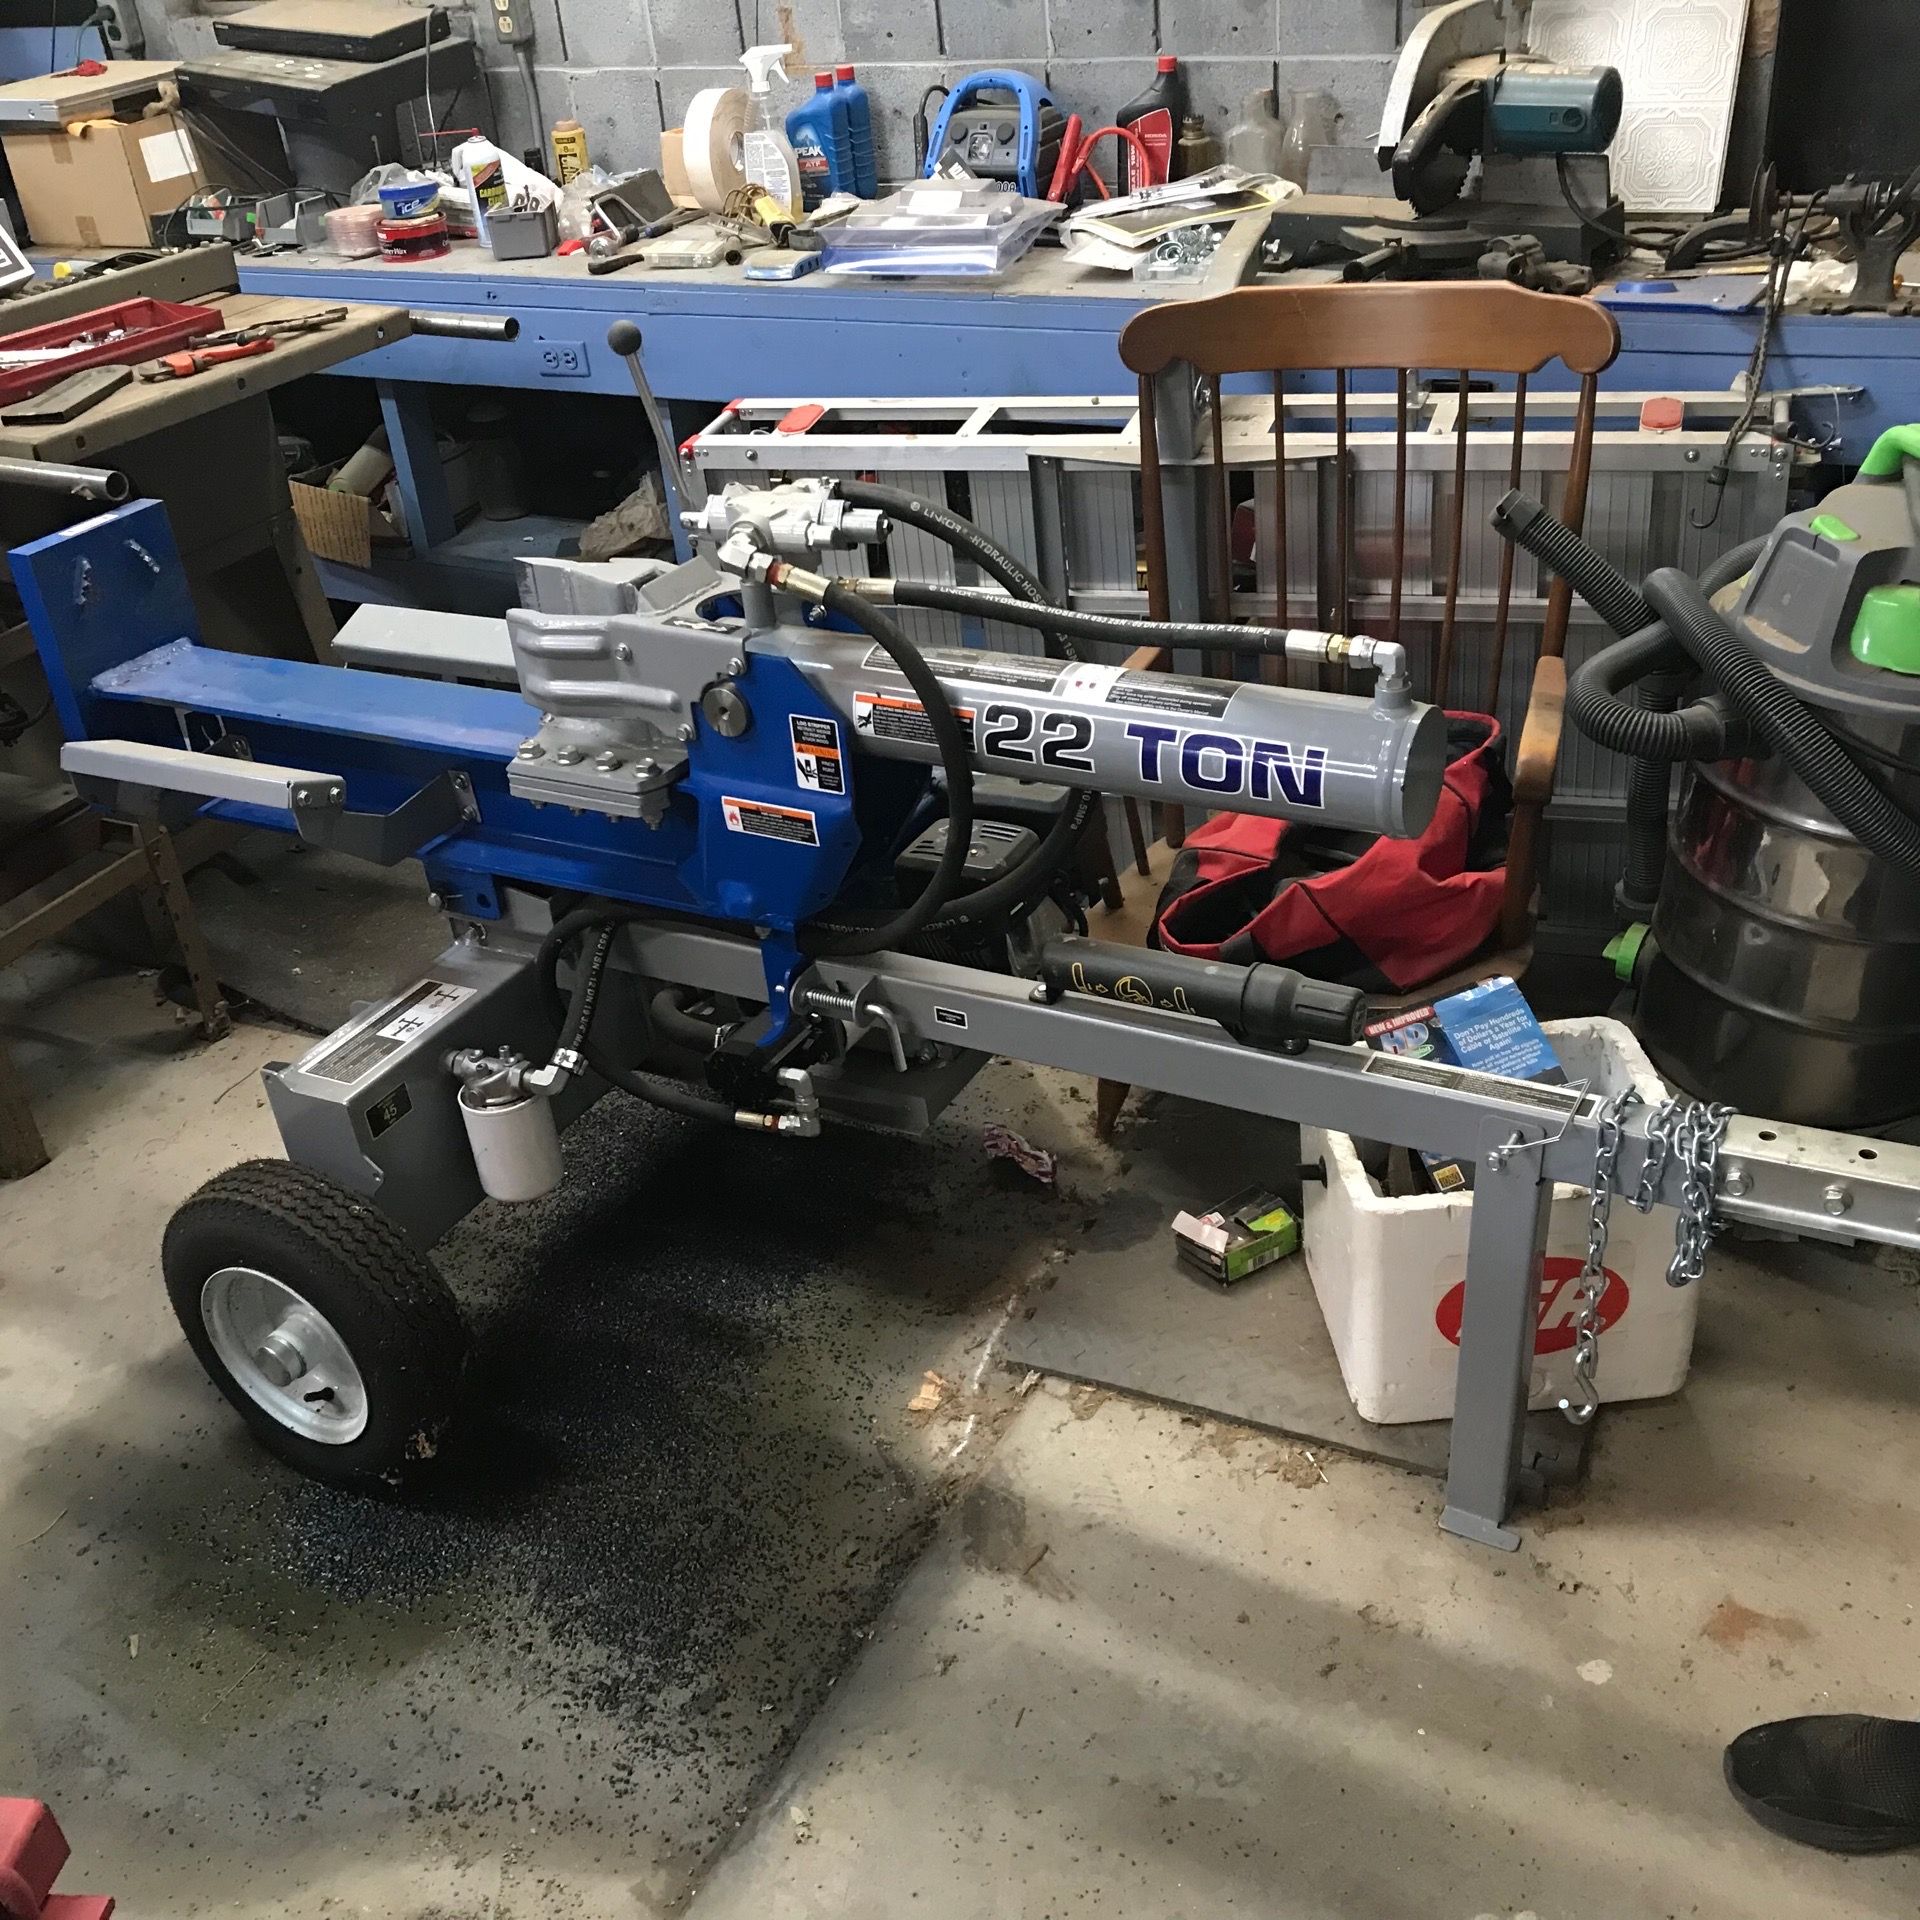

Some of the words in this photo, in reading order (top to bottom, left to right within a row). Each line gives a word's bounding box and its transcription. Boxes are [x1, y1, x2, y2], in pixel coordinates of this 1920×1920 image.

[794, 145, 824, 158] PEAK
[983, 701, 1096, 773] 22
[1123, 718, 1329, 810] TON
[1368, 1022, 1386, 1035] NEW
[1392, 1006, 1430, 1026] IMPROVED
[1453, 1027, 1474, 1040] Don't
[1474, 1023, 1489, 1032] Pay
[1489, 1008, 1525, 1025] Hundreds
[1466, 1029, 1493, 1043] Dollars
[1499, 1019, 1516, 1030] Year
[1516, 1015, 1528, 1023] for
[1461, 1041, 1482, 1054] Cable
[1492, 1026, 1521, 1041] Satellite
[1521, 1020, 1532, 1029] TV
